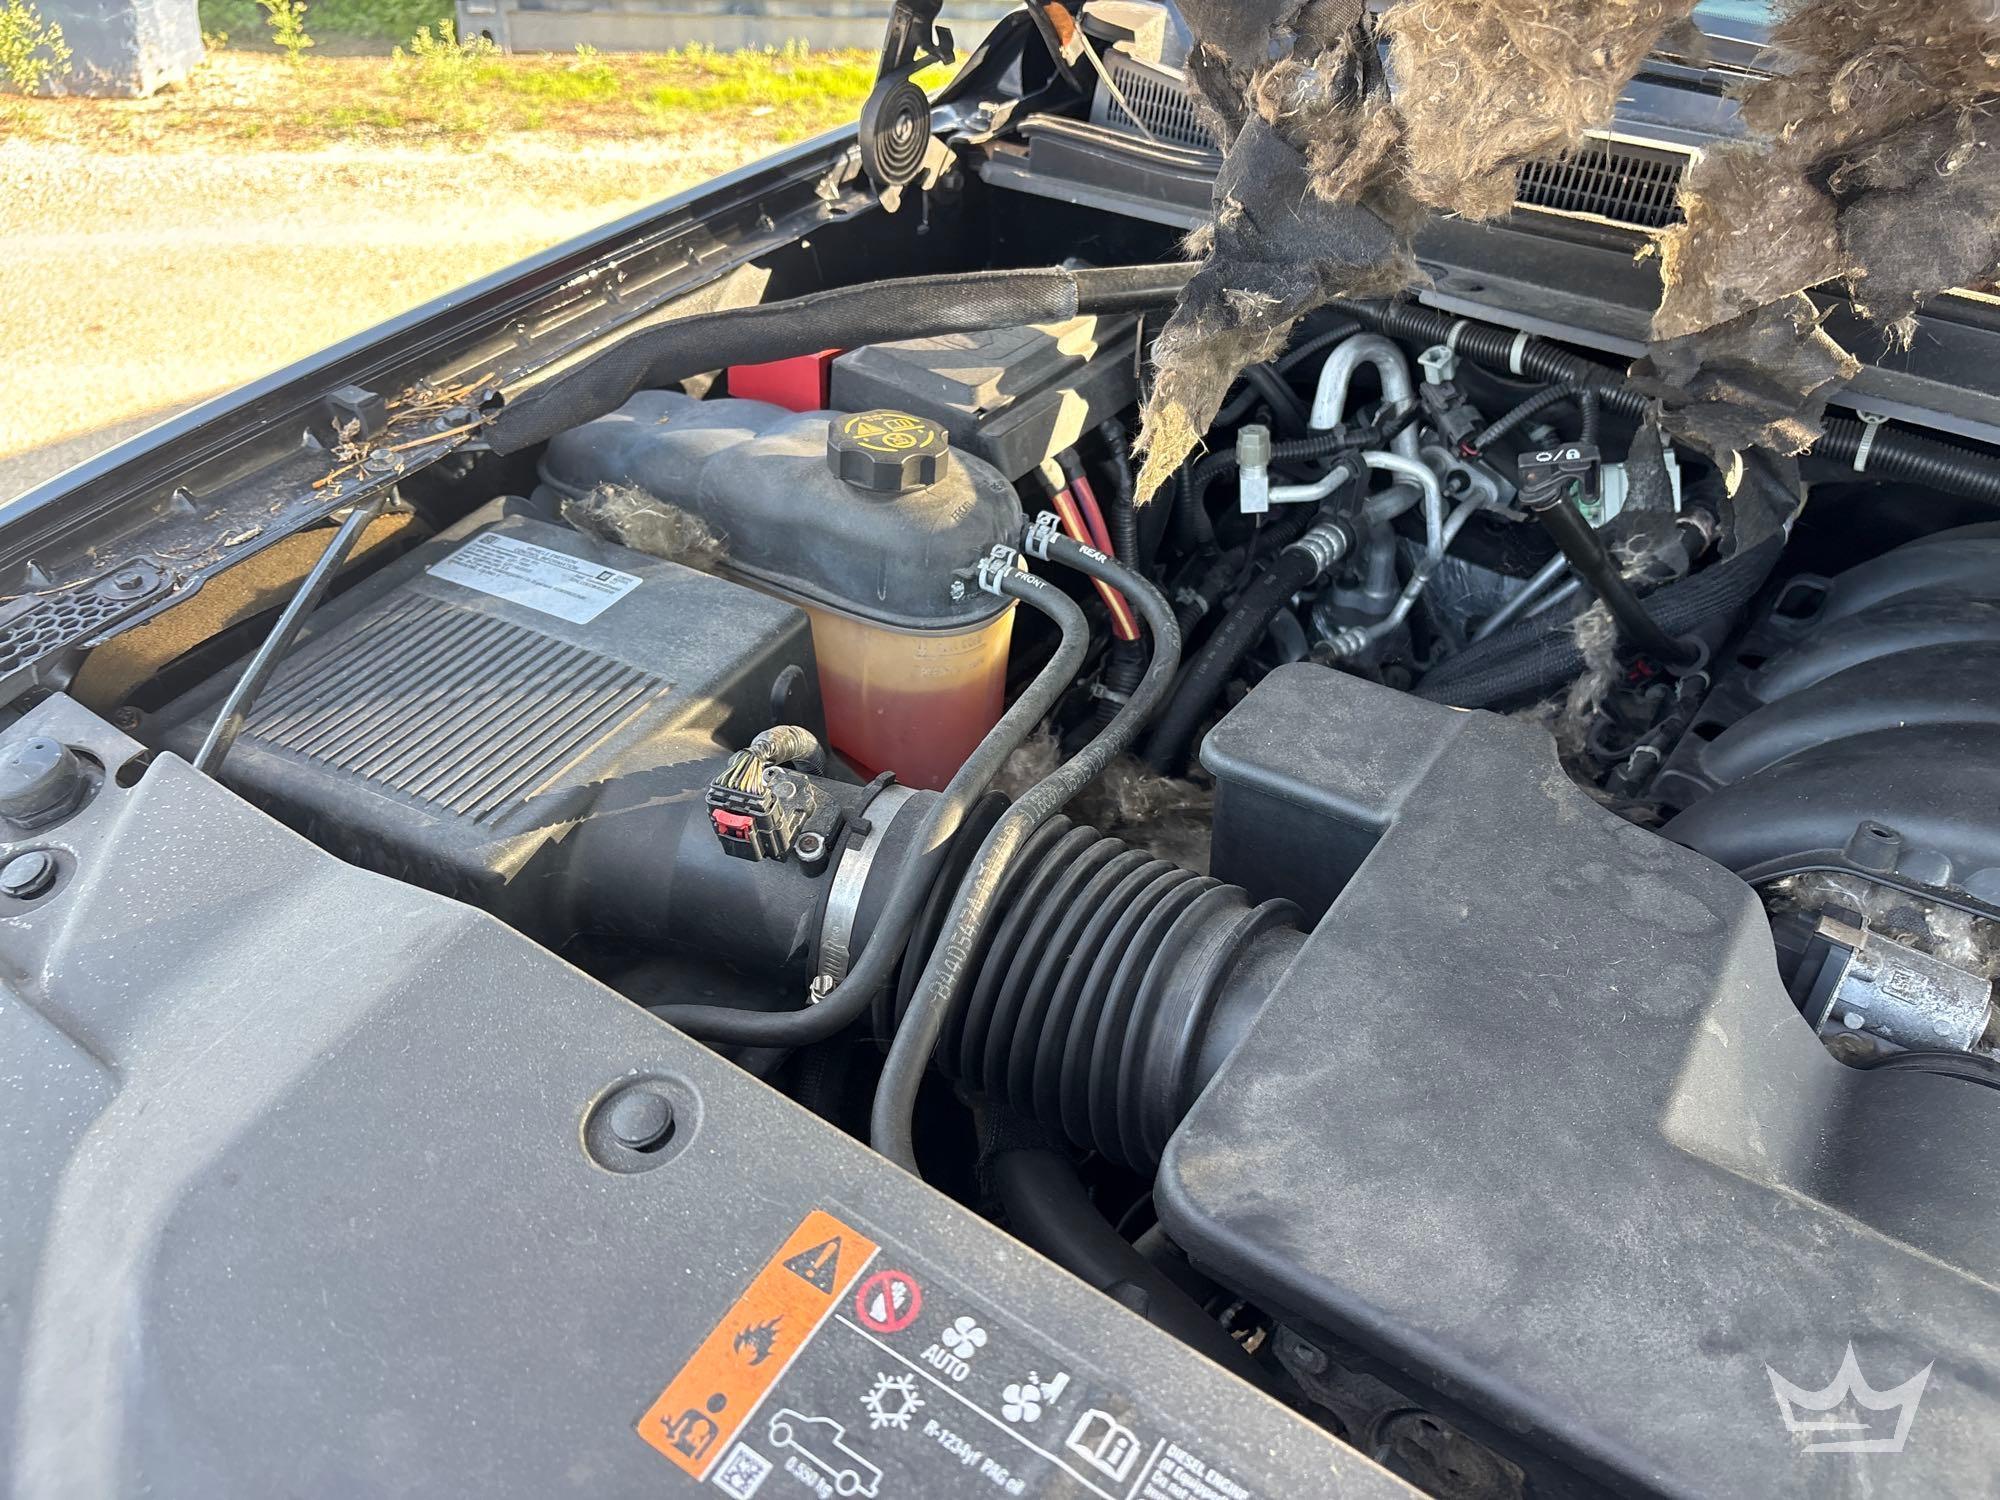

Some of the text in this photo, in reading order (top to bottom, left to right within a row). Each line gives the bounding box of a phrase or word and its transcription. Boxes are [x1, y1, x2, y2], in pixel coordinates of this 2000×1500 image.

[1078, 544, 1108, 565] REAR
[1014, 571, 1048, 590] FRONT
[920, 1343, 971, 1382] AUTO
[923, 1419, 983, 1466] R-1234yf
[980, 1458, 1010, 1486] PAG
[1166, 1443, 1206, 1478] DIESEL
